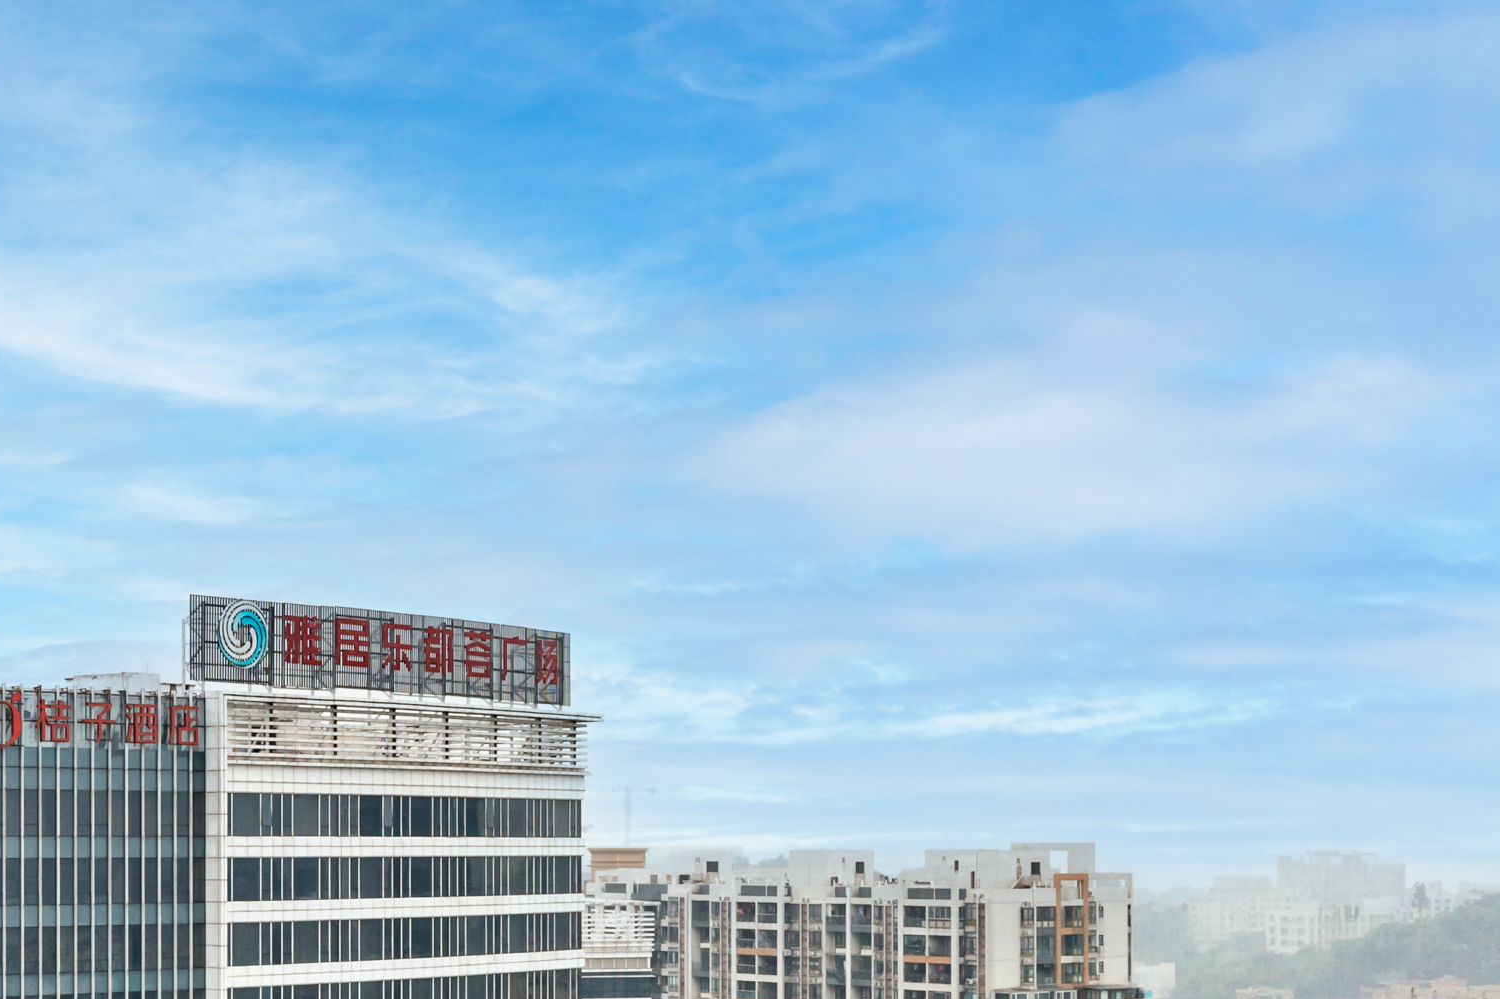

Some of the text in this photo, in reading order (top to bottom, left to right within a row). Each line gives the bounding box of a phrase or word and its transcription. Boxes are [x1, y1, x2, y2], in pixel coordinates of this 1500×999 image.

[284, 614, 559, 685] 雅居乐都荟广场
[35, 699, 200, 746] 桔子酒店
